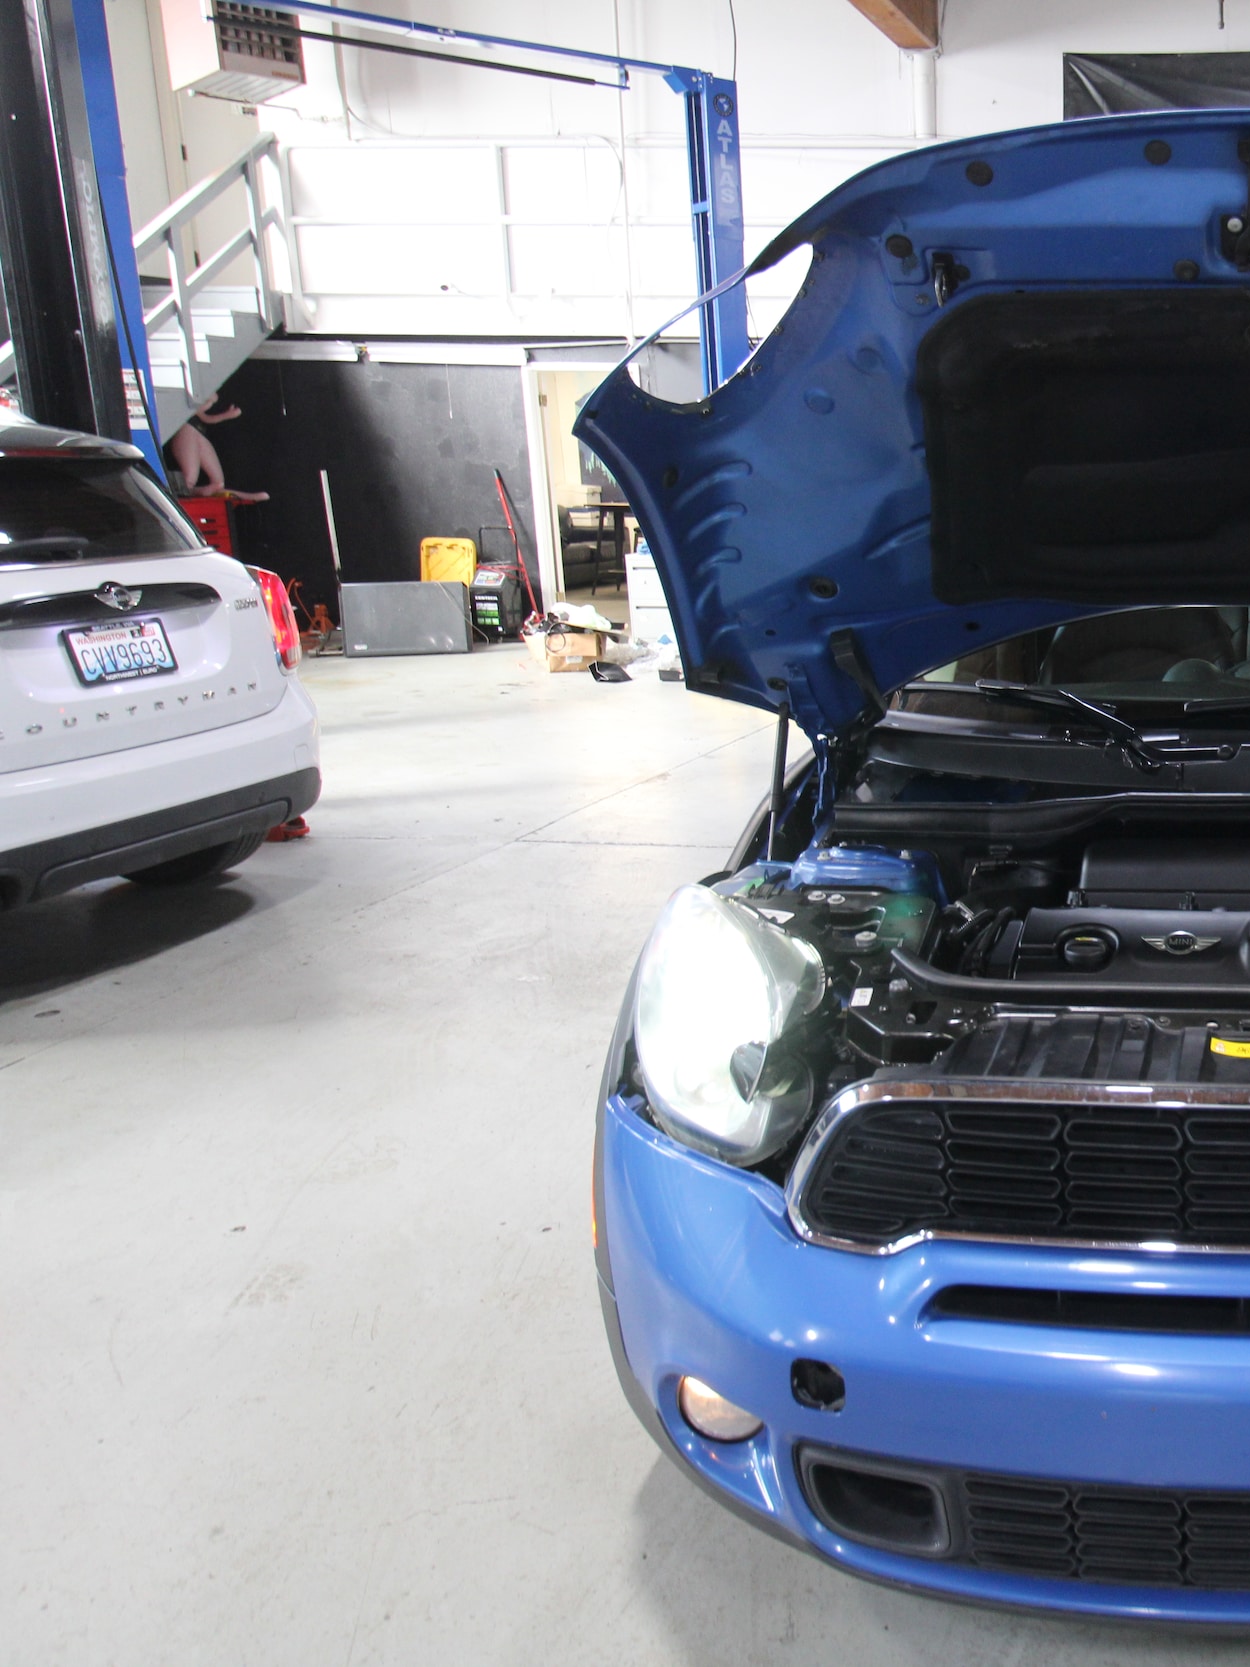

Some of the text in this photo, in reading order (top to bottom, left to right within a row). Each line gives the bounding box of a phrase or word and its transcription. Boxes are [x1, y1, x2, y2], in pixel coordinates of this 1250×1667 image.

[717, 119, 735, 203] ATLAS
[76, 632, 127, 645] WASHINGTON
[81, 639, 166, 675] CVV9693
[1168, 938, 1193, 946] MINI
